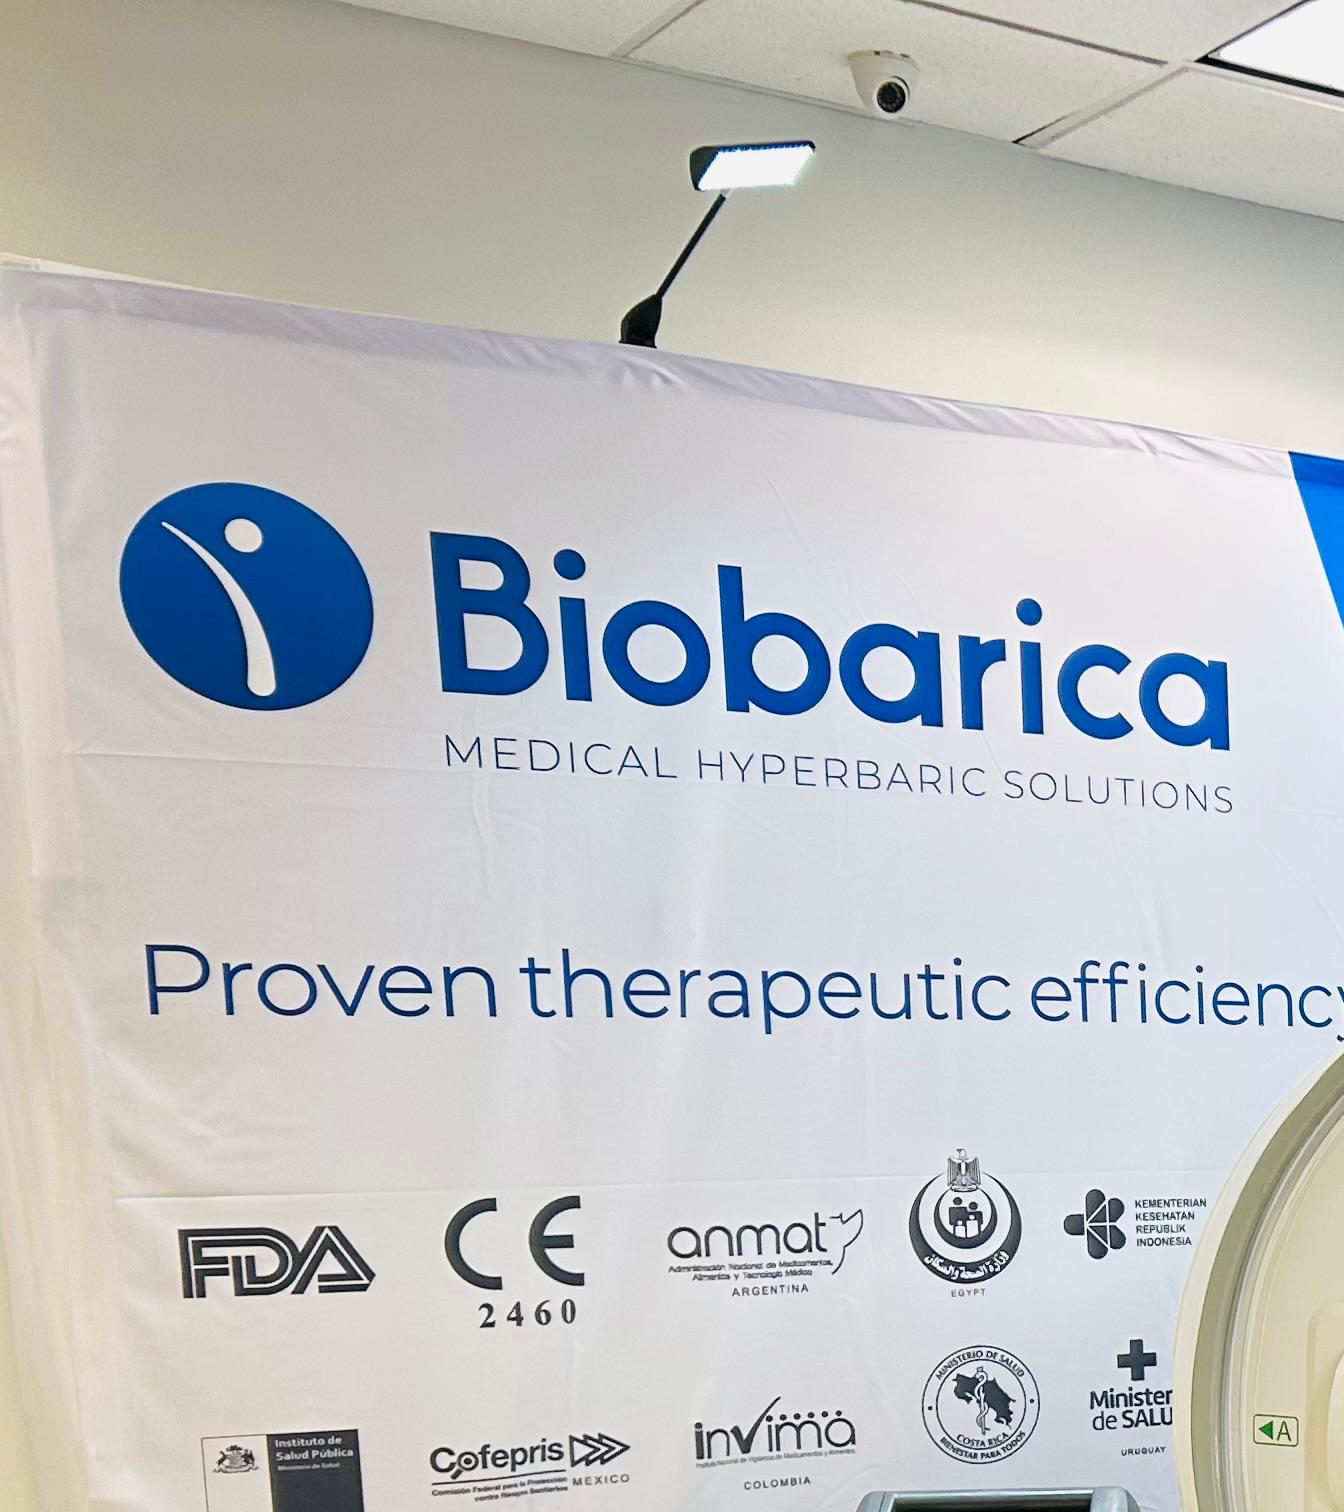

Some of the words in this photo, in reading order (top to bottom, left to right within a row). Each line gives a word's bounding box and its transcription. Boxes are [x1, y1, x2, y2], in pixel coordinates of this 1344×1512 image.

[428, 530, 1231, 752] Biobarica
[444, 733, 679, 780] MEDICAL
[697, 756, 987, 799] HYPERBARIC
[1002, 769, 1234, 815] SOLUTIONS
[142, 942, 495, 1020] Proven
[519, 948, 1008, 1036] therapeutic
[1134, 1198, 1207, 1208] KEMENTERIAN
[1135, 1211, 1195, 1221] KESEHATAN
[668, 1212, 828, 1259] anmat
[1136, 1224, 1187, 1234] REPUBLIK
[445, 1195, 586, 1291] CE
[1136, 1236, 1192, 1247] INDONESIA
[178, 1225, 377, 1299] FDA
[732, 1283, 809, 1297] ARGENTINA
[951, 1288, 986, 1297] EGYPT
[478, 1299, 577, 1329] 2460
[935, 1350, 983, 1381] MINISTERIO
[985, 1350, 998, 1360] DE
[998, 1354, 1025, 1378] SALUD
[1090, 1386, 1173, 1409] Minister
[694, 1396, 857, 1460] invima
[1092, 1410, 1118, 1430] de
[1122, 1407, 1173, 1428] SALU
[274, 1438, 325, 1448] Instituto
[327, 1435, 342, 1445] de
[956, 1433, 986, 1448] COSTA
[988, 1432, 1010, 1446] RICA
[1276, 1420, 1292, 1441] A
[275, 1449, 309, 1461] Salud
[311, 1447, 354, 1459] Pública
[980, 1450, 1001, 1460] PARA
[1001, 1430, 1026, 1453] TODOS
[1120, 1446, 1166, 1456] URUGUAY
[430, 1438, 564, 1480] Cofepris
[573, 1473, 630, 1486] MEXICO
[744, 1476, 811, 1490] COLOMBIA
